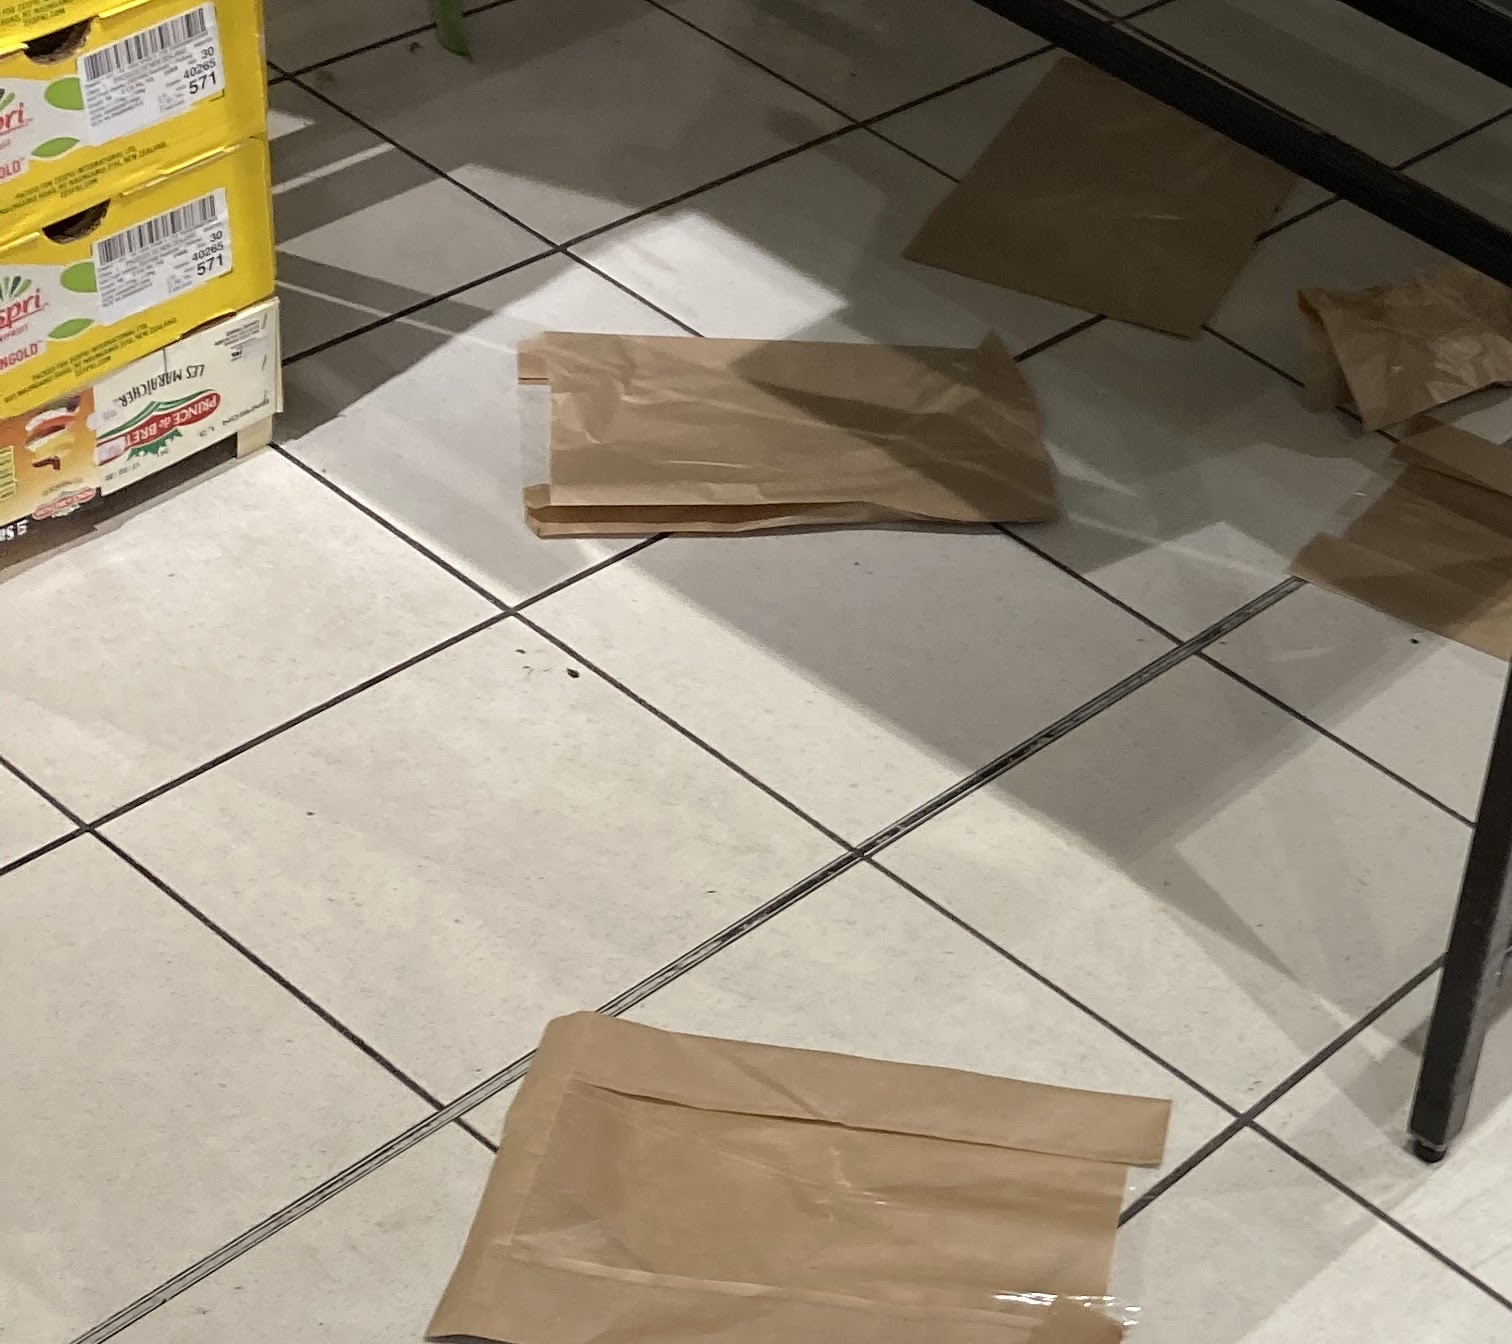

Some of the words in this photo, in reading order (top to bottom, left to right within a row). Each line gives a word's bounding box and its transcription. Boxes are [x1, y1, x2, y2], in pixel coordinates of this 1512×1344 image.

[201, 46, 215, 60] 30
[183, 60, 217, 80] 40265
[189, 71, 217, 95] 571
[210, 230, 223, 243] 30
[192, 243, 225, 262] 40265
[196, 254, 224, 276] 571
[186, 364, 205, 379] LES
[173, 395, 217, 425] PRINCE
[158, 416, 171, 428] de
